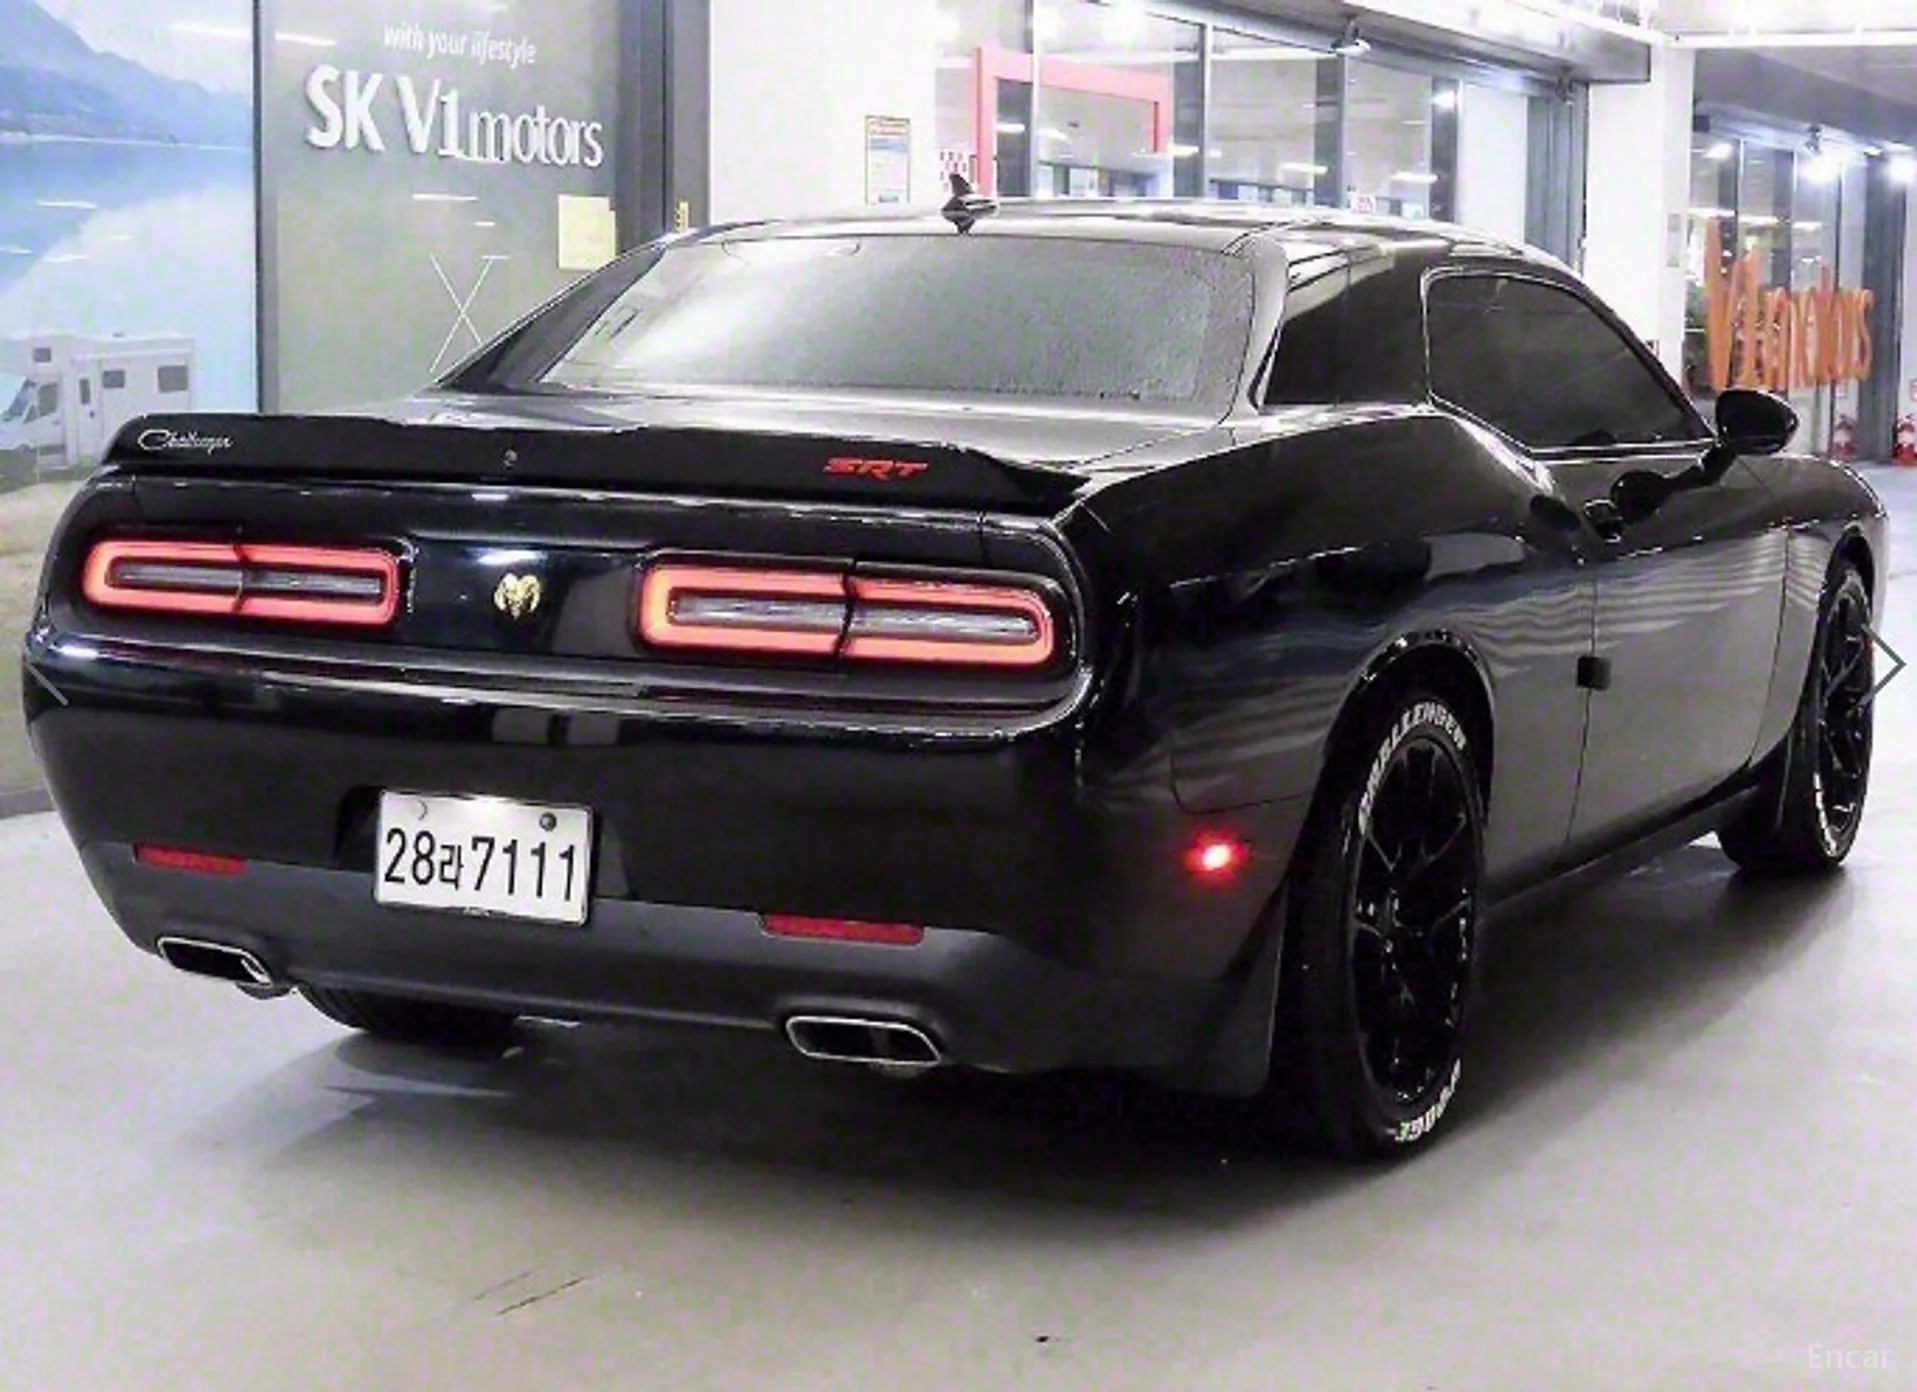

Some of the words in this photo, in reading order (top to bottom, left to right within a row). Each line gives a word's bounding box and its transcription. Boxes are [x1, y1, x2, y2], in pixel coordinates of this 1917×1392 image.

[384, 22, 423, 51] with
[426, 32, 468, 60] your
[471, 30, 537, 69] lifestyle
[305, 65, 385, 150] SK
[823, 456, 929, 481] SRT
